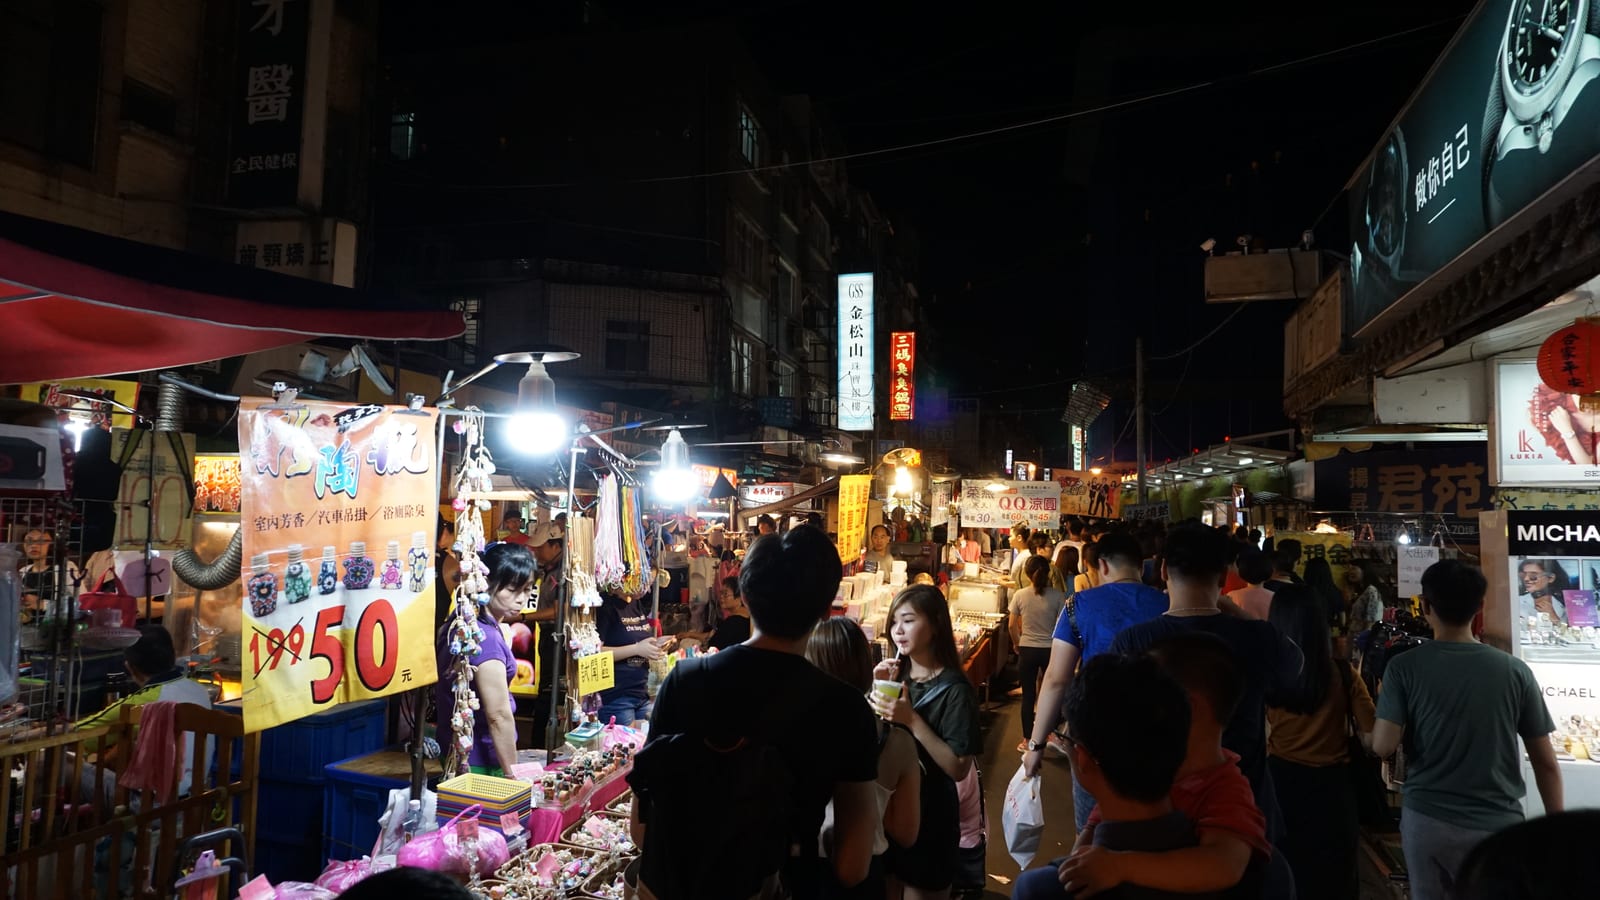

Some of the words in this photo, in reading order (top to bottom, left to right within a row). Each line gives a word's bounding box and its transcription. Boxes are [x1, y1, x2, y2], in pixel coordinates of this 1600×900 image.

[232, 152, 298, 175] 全民健保
[1415, 123, 1470, 212] 做你自己
[848, 283, 863, 298] GSS
[849, 305, 864, 358] 金松山
[895, 336, 911, 403] 三媽臭臭鍋
[1376, 462, 1484, 519] 君苑
[249, 623, 305, 675] 199
[310, 599, 399, 704] 50
[1542, 686, 1596, 698] ICHAEL
